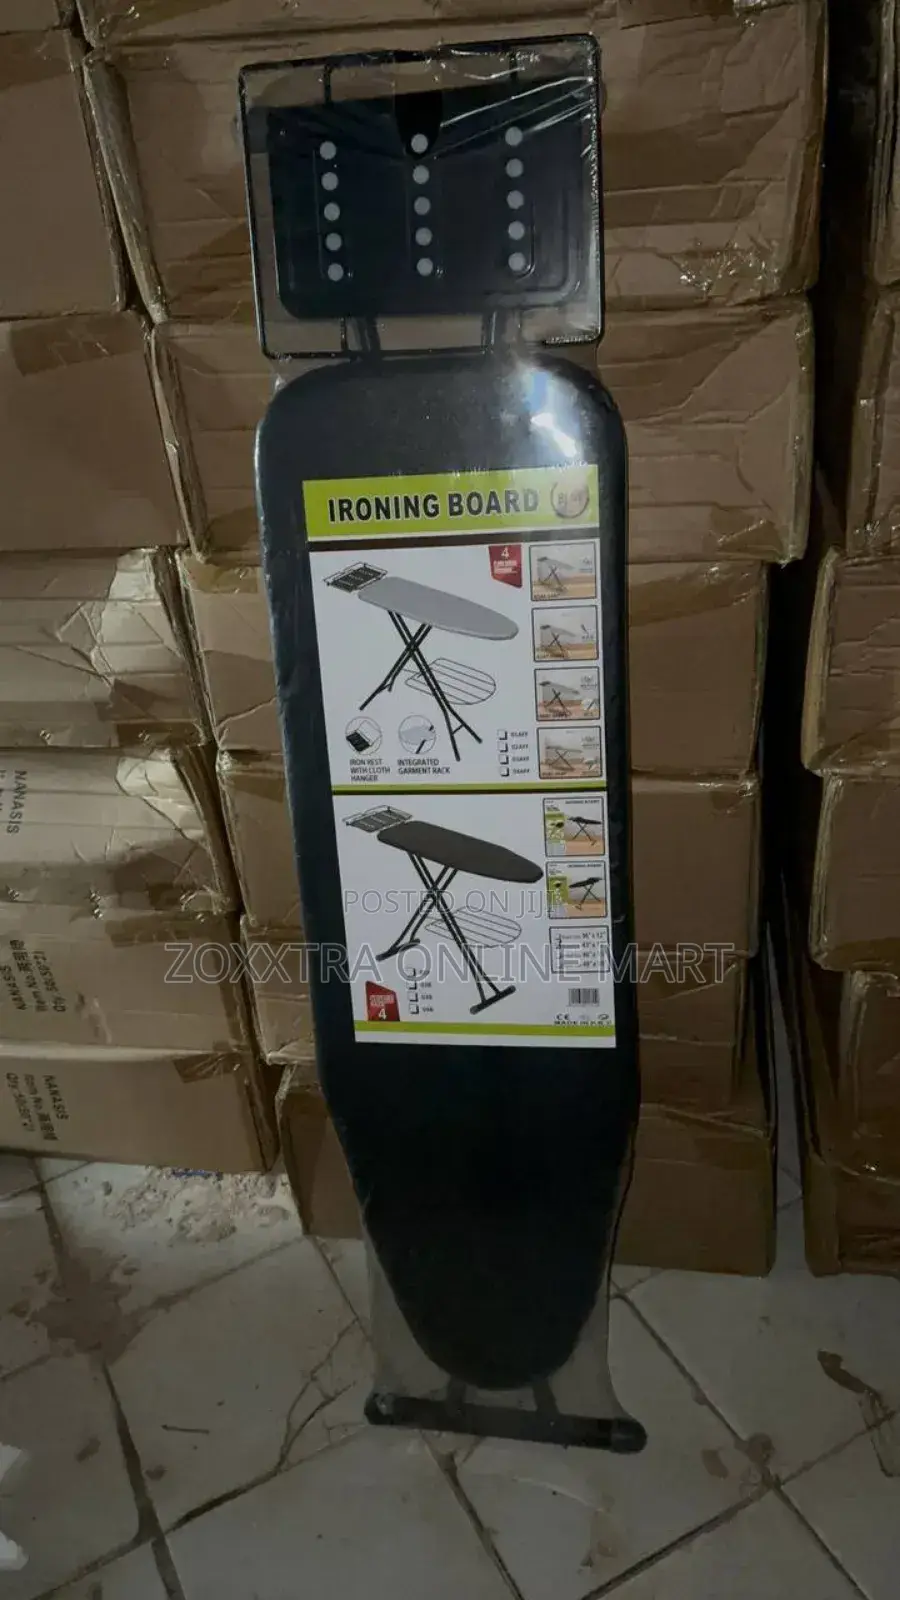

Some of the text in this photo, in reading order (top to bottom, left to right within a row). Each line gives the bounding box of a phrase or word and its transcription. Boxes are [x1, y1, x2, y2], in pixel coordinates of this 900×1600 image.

[328, 493, 440, 522] IRONING
[447, 488, 539, 517] BOARD
[501, 546, 510, 558] 4
[350, 766, 390, 774] WITH CLOTH
[432, 766, 450, 774] RACK
[6, 769, 27, 834] NANASIS
[378, 1008, 387, 1020] 4
[42, 1074, 70, 1119] NANASIS
